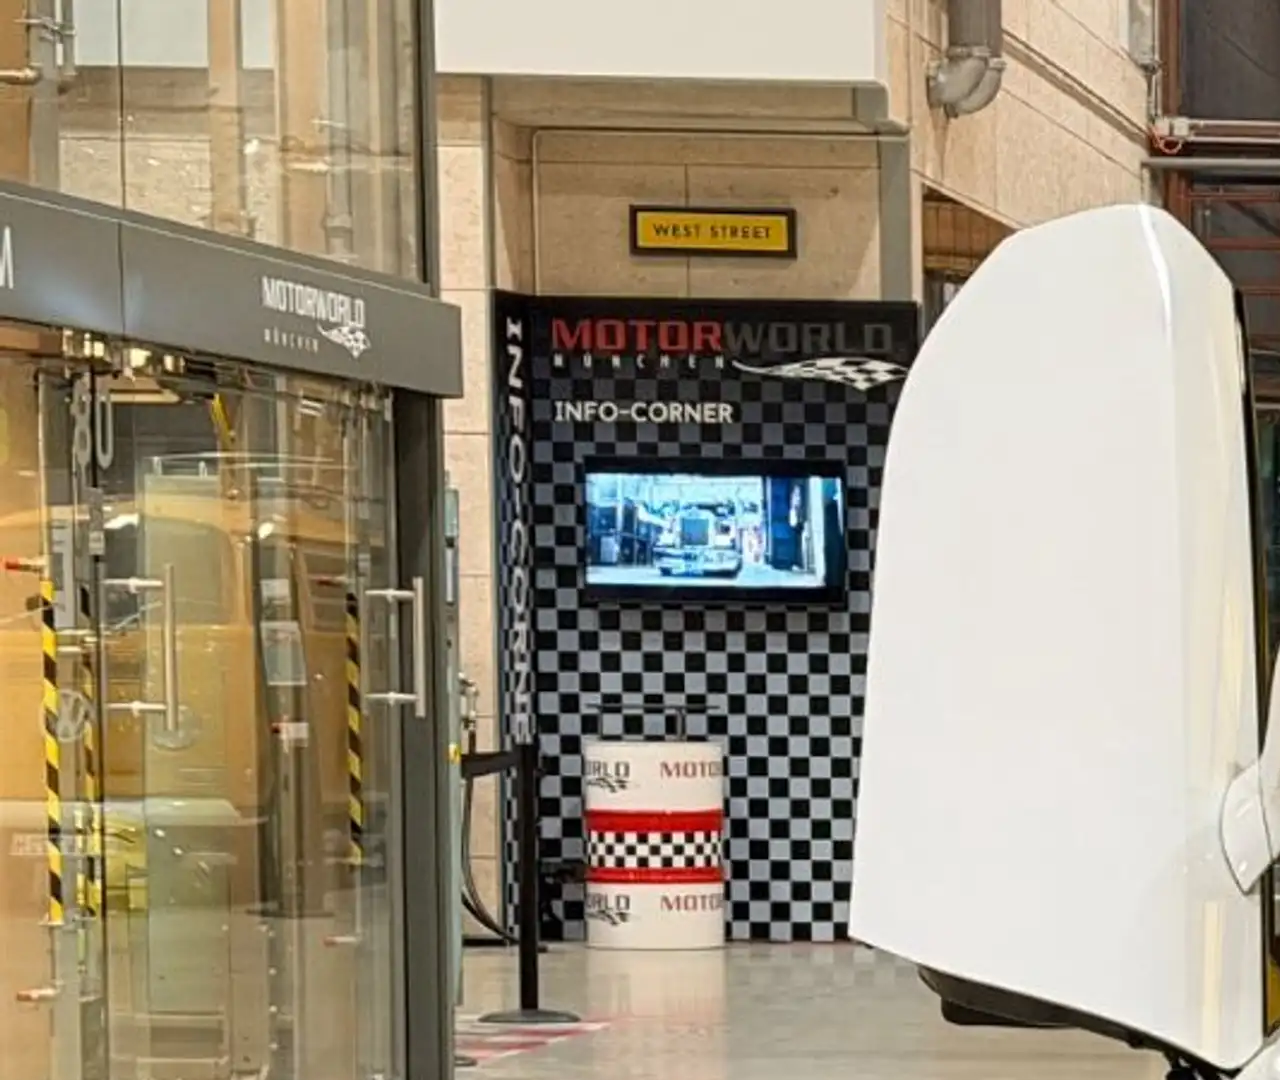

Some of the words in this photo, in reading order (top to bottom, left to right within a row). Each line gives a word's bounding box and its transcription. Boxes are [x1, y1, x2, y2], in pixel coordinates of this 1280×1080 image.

[653, 223, 700, 239] WEST
[710, 224, 771, 240] STREET
[262, 276, 365, 329] MOTORWORLD
[552, 318, 893, 350] MOTORWORLD
[554, 353, 724, 368] MÜNCHEN
[555, 401, 733, 423] INFO-CORNER
